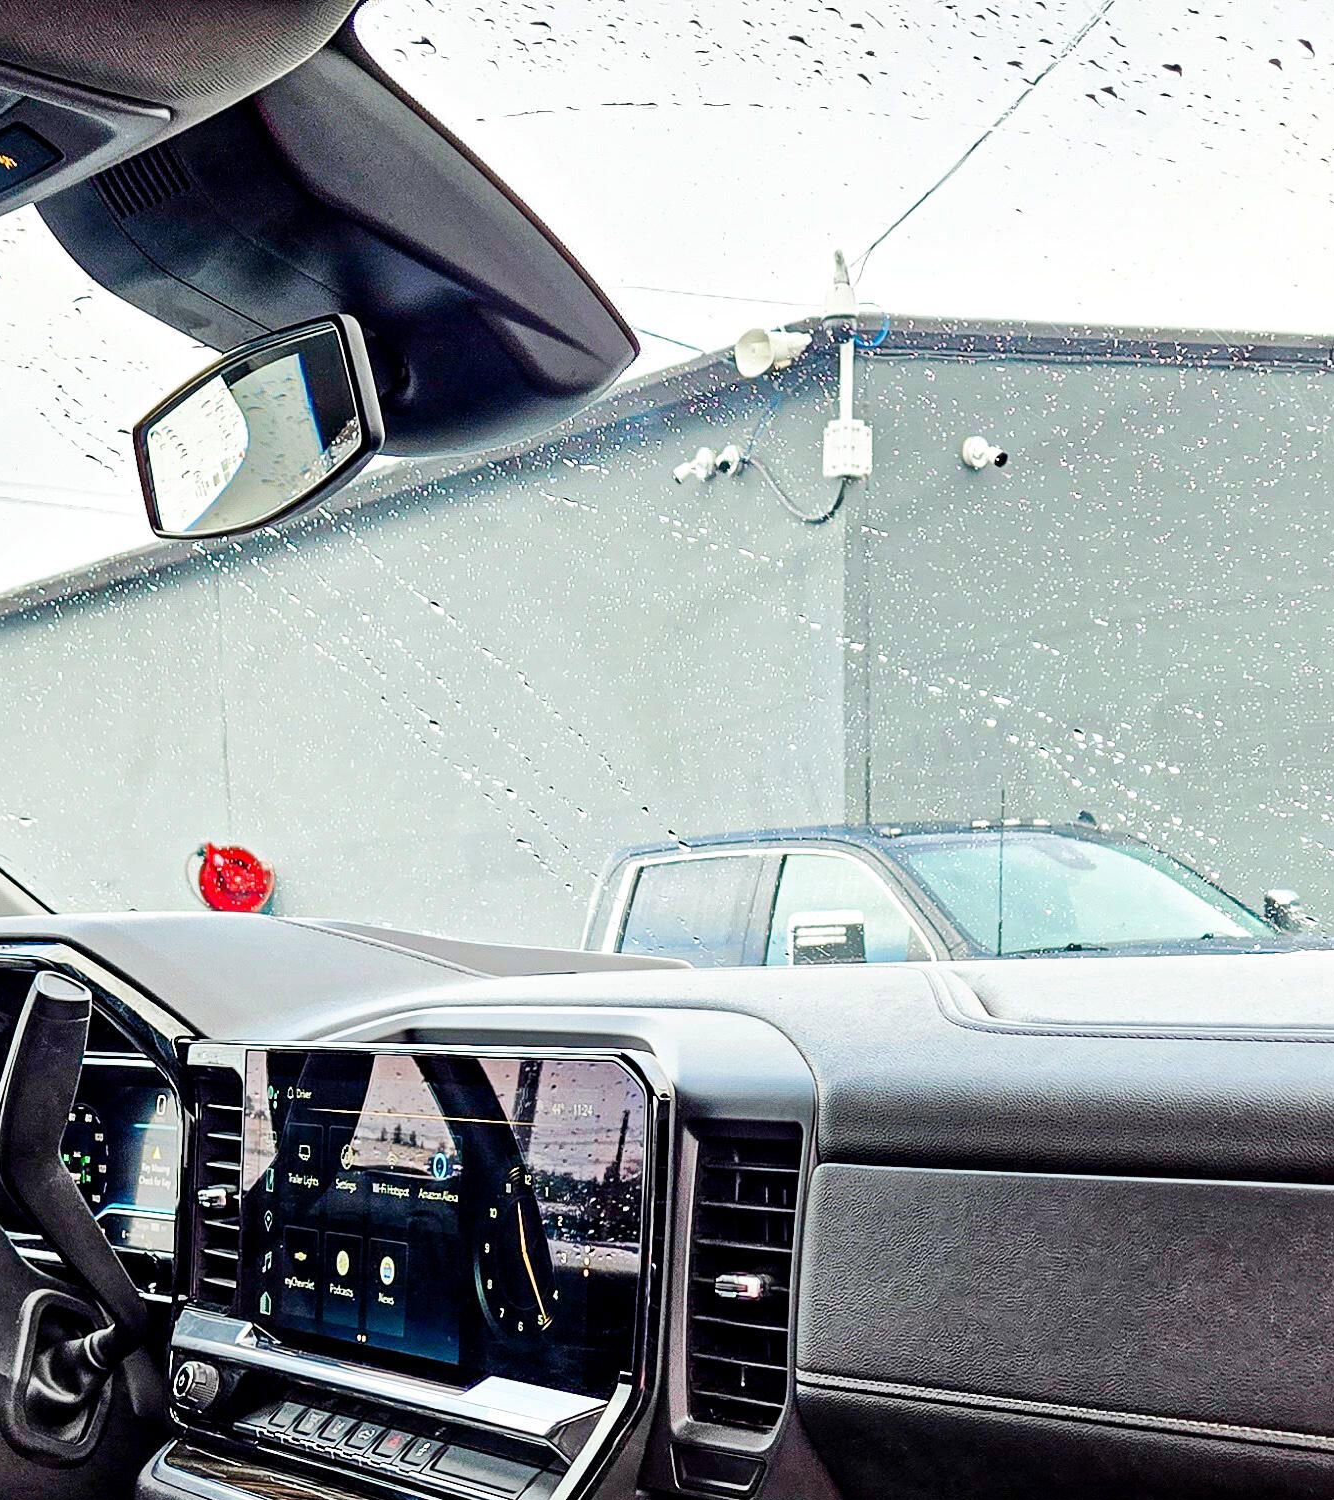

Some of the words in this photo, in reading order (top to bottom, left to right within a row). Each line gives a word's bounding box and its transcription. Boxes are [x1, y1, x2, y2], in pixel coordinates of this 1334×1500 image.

[156, 1094, 167, 1116] 0
[335, 1178, 357, 1194] Settings
[557, 1215, 563, 1227] 2
[484, 1242, 490, 1254] 9
[552, 1289, 559, 1300] 4
[499, 1307, 505, 1319] 7
[517, 1321, 524, 1332] 6
